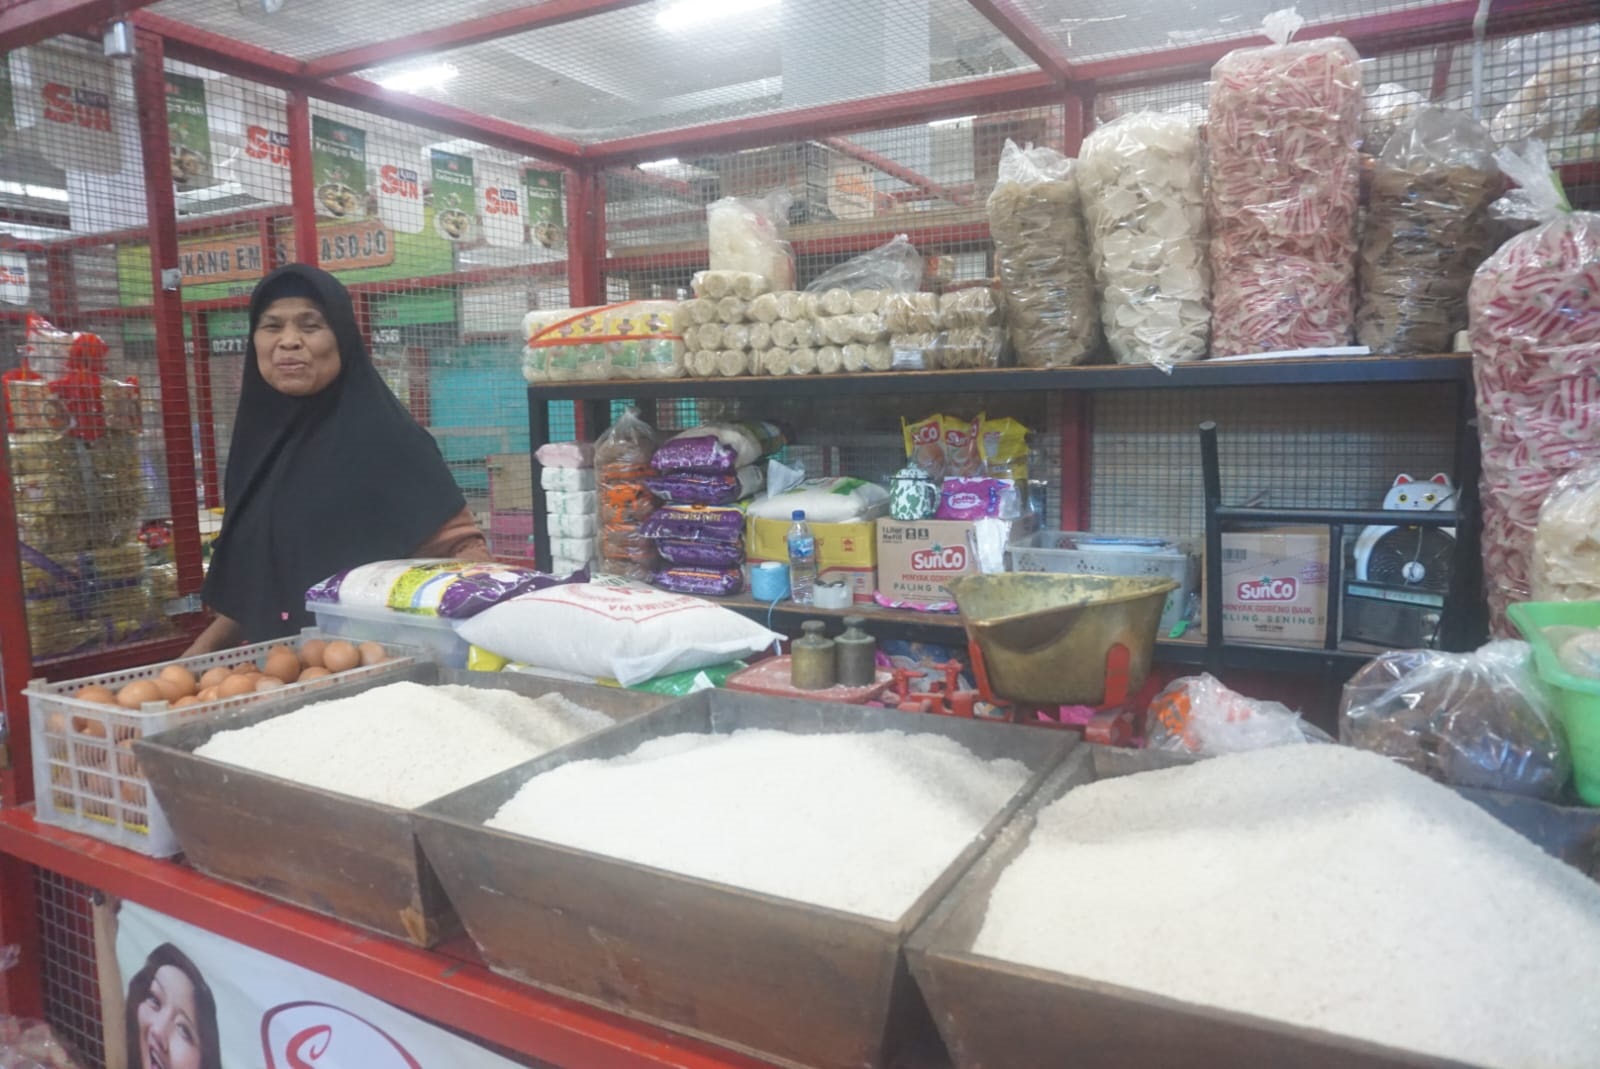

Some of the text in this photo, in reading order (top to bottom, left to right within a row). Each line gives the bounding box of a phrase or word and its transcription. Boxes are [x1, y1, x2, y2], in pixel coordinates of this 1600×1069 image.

[914, 549, 963, 570] SunCo
[893, 583, 932, 592] PALING
[1240, 580, 1294, 600] SunCo
